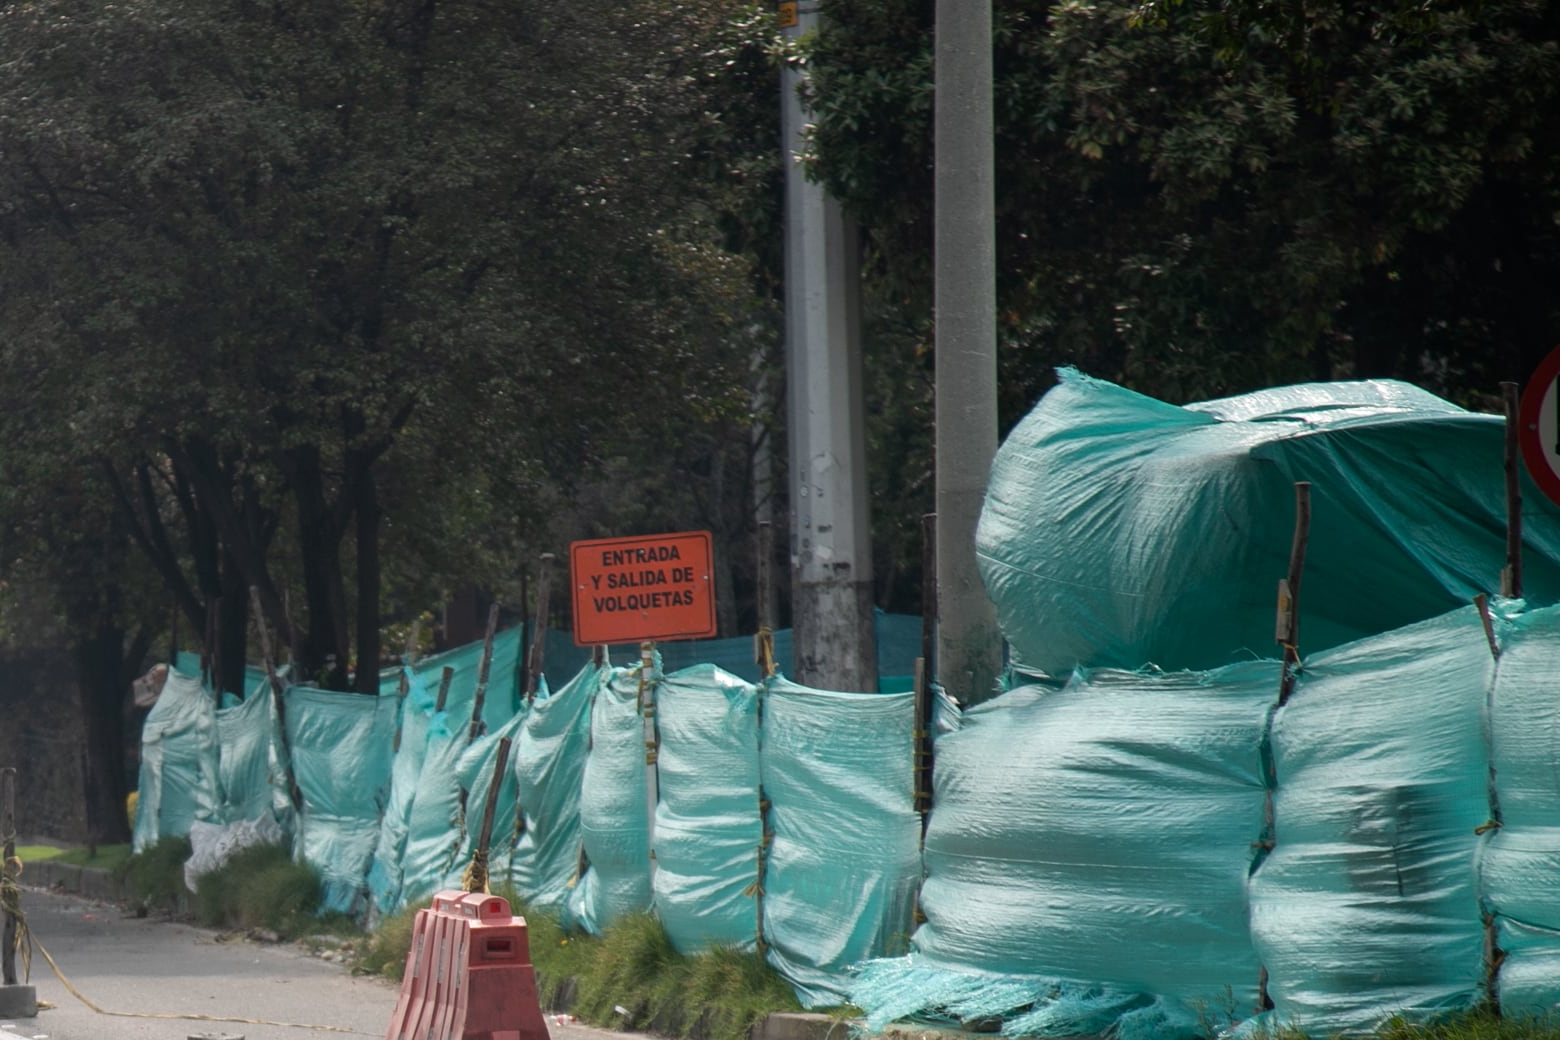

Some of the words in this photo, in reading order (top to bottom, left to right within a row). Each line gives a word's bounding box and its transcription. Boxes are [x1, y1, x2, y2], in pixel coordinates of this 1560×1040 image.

[602, 545, 680, 567] ENTRADA
[591, 574, 603, 590] Y
[608, 570, 667, 589] SALIDA
[672, 567, 694, 583] DE
[593, 590, 694, 613] VOLQUETAS
